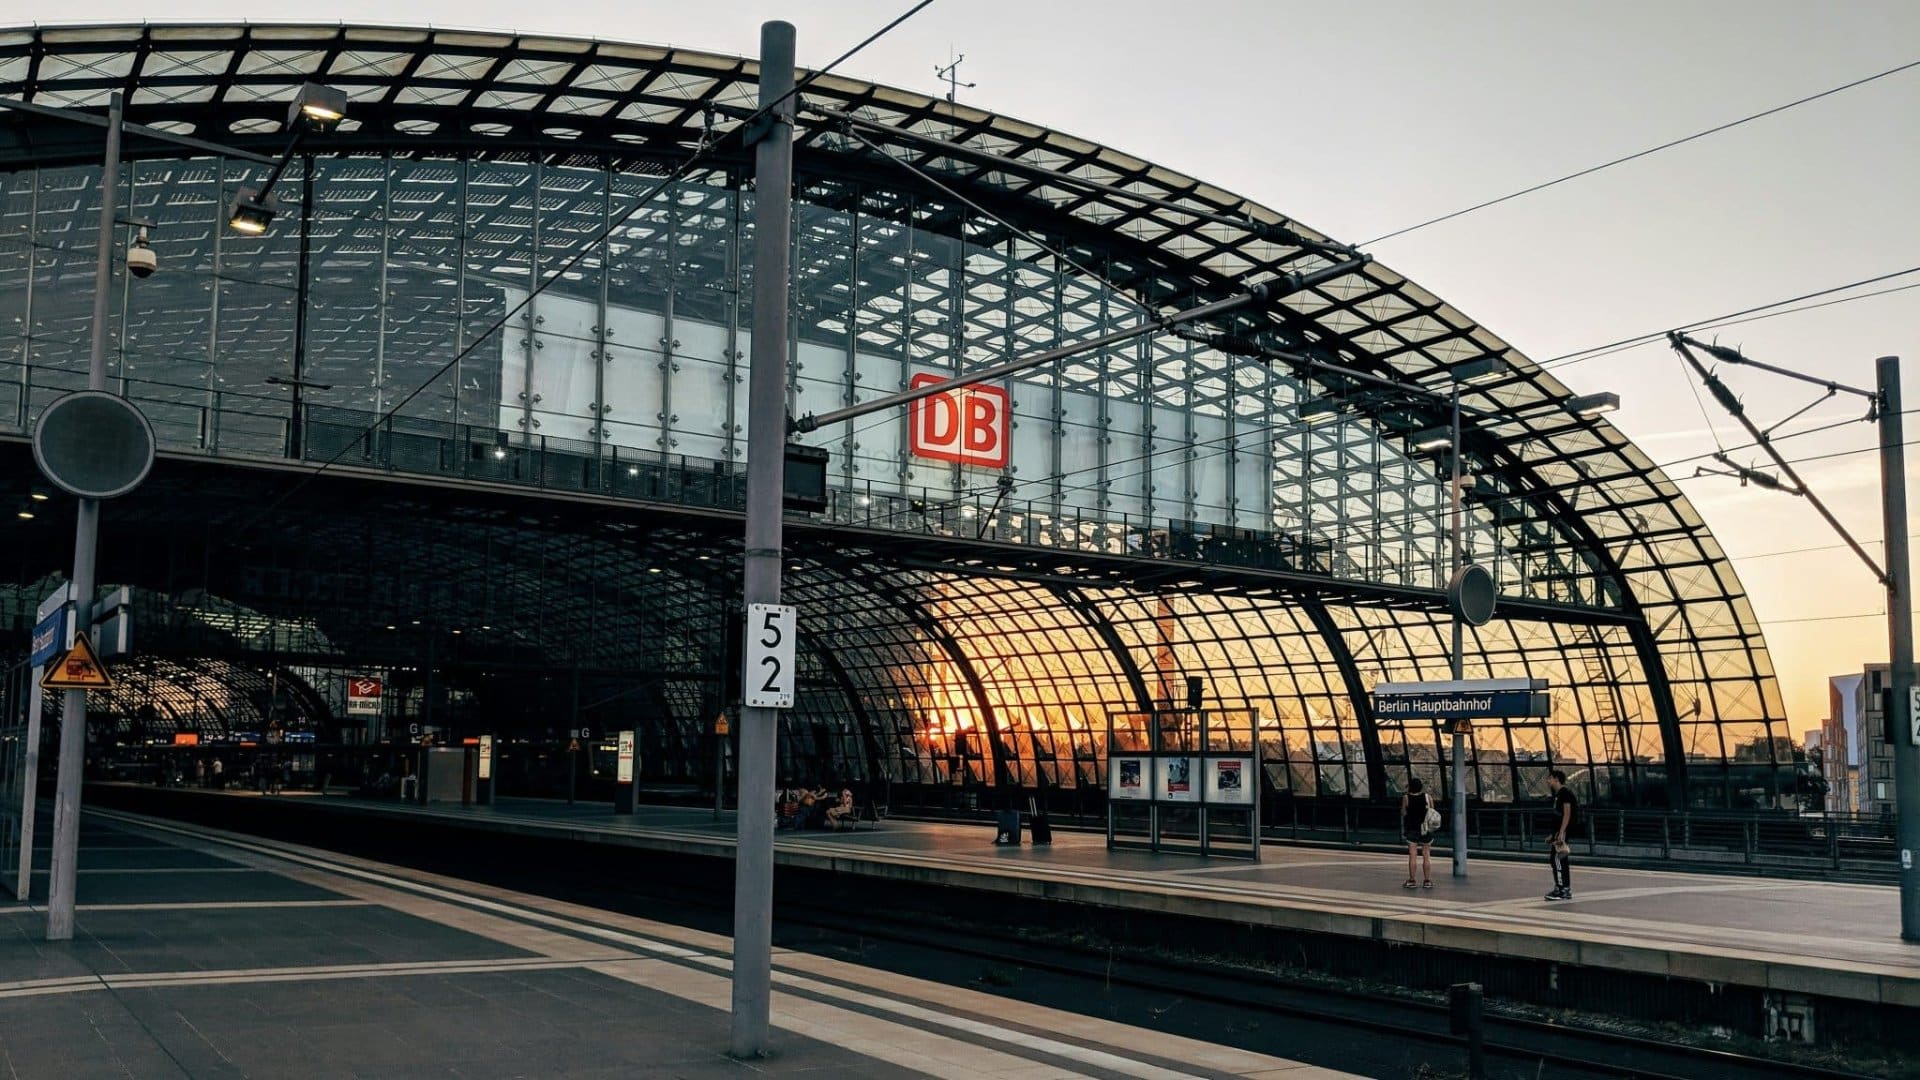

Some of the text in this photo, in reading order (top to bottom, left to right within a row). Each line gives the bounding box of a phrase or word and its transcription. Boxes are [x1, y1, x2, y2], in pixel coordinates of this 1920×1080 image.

[923, 389, 998, 452] DB
[760, 612, 782, 648] 5
[760, 655, 781, 693] 2
[1378, 697, 1492, 714] Berlin Hauptbahnhof
[409, 723, 418, 734] G
[581, 728, 590, 738] G
